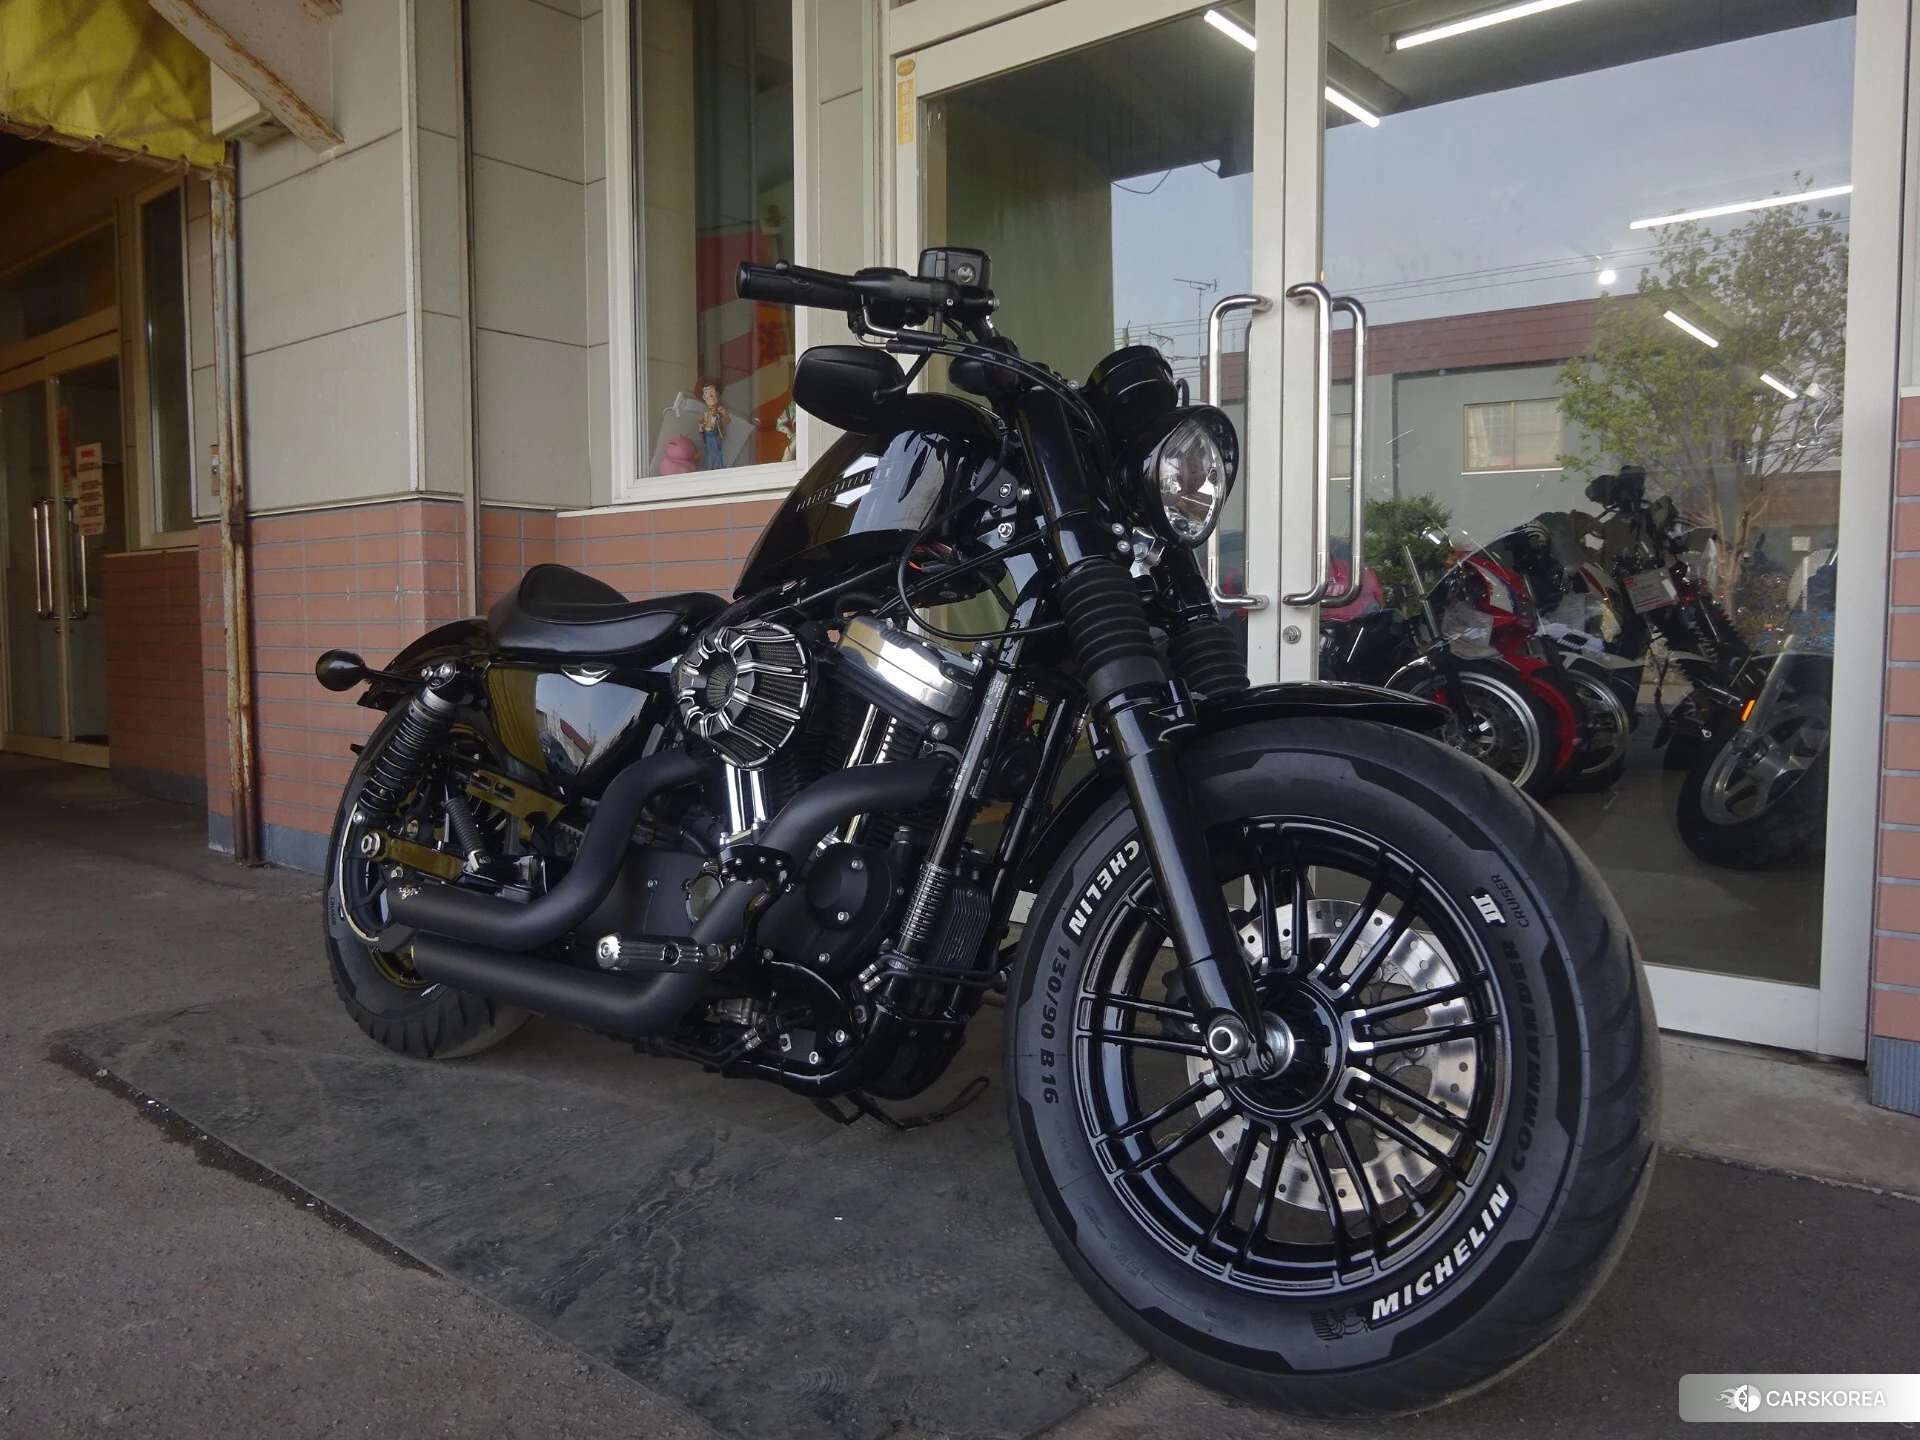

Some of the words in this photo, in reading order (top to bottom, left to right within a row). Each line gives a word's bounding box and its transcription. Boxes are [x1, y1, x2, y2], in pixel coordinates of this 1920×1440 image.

[1068, 840, 1140, 936] CHELIN
[1490, 874, 1529, 928] CRUISER
[1040, 945, 1071, 1040] 130/90
[1040, 1047, 1055, 1067] B
[1041, 1075, 1059, 1106] 16
[1502, 940, 1541, 1172] COMMANDER
[1372, 1183, 1509, 1320] MICHELIN
